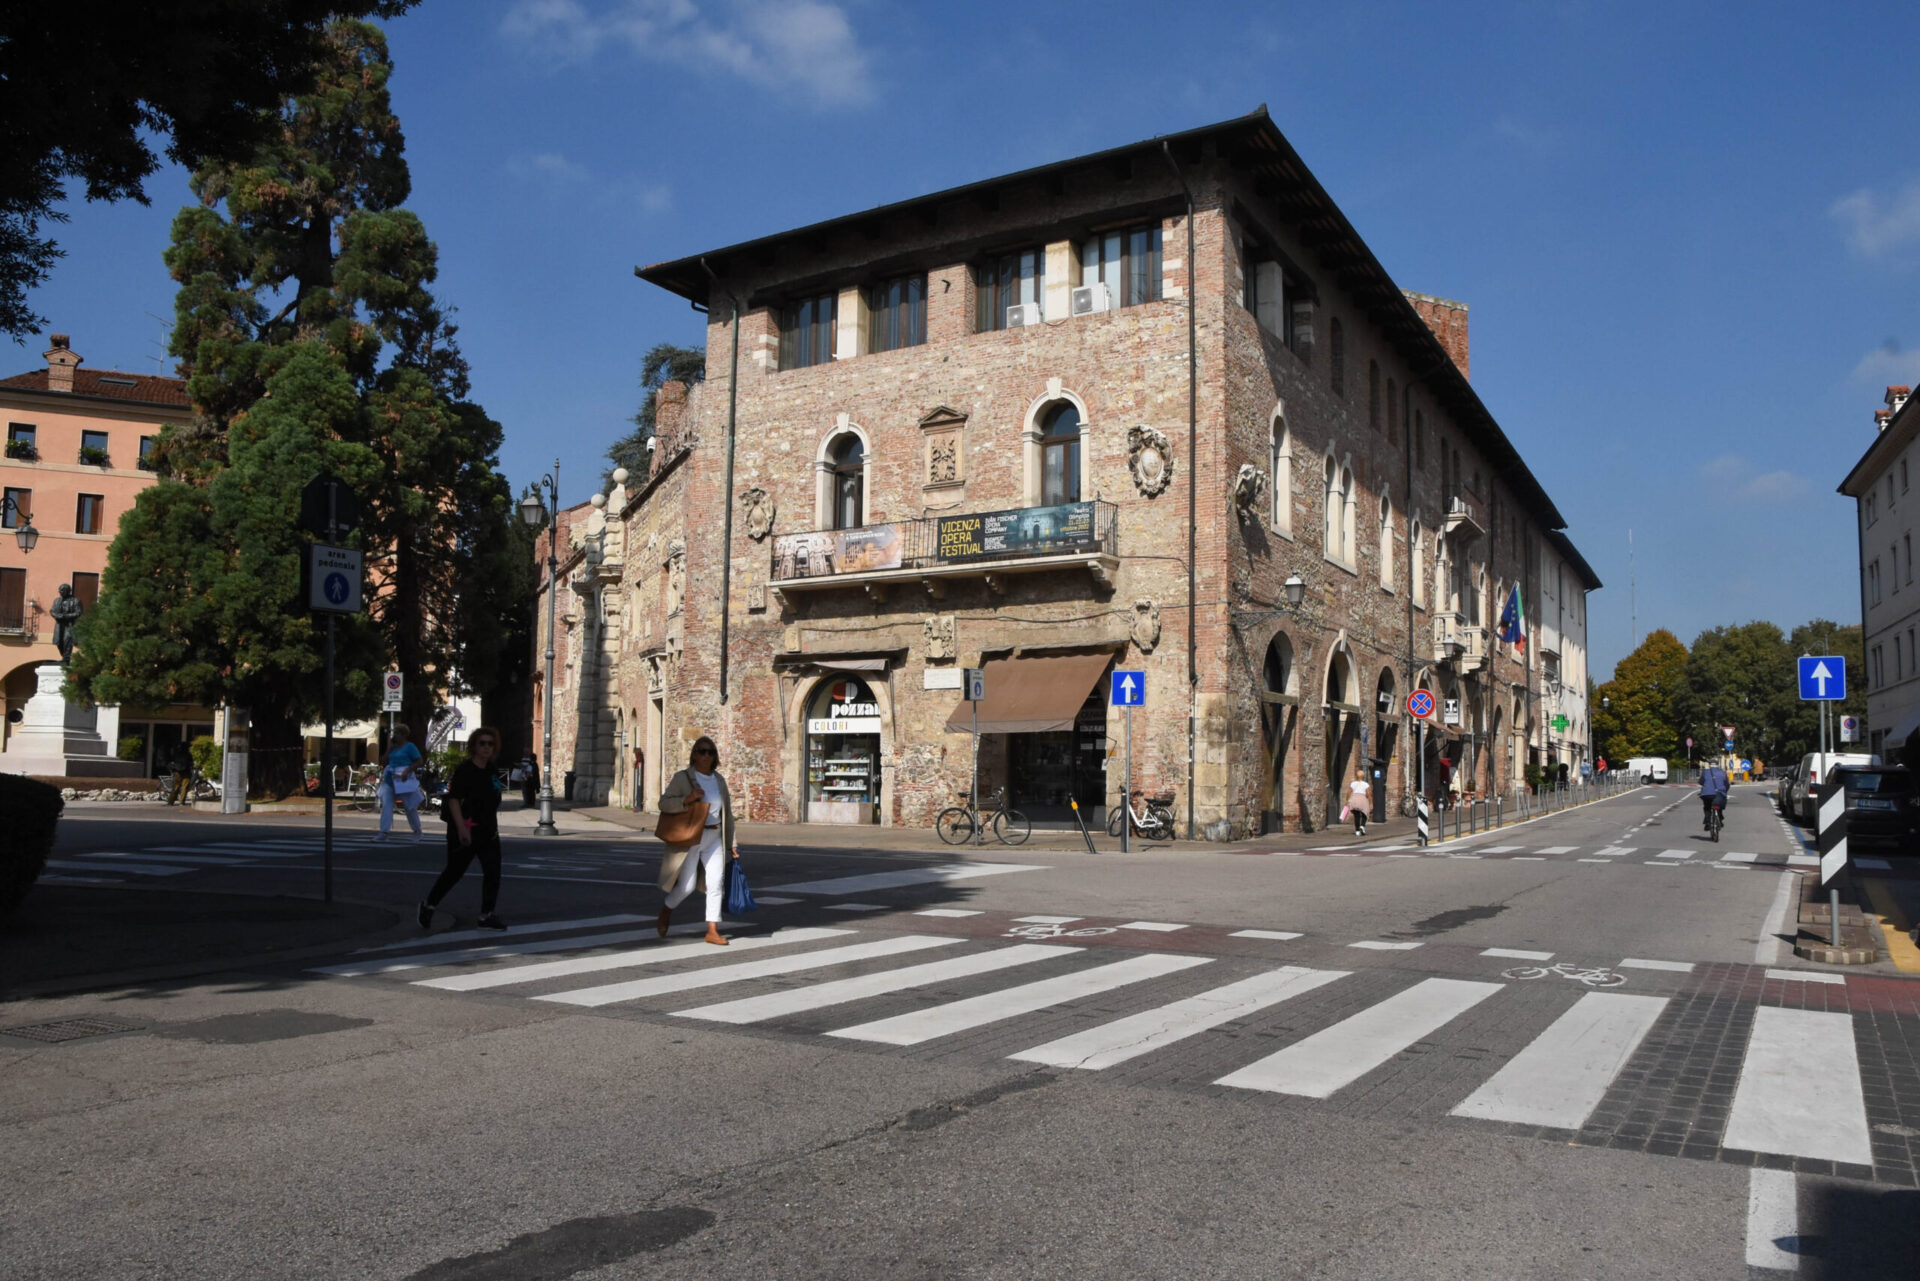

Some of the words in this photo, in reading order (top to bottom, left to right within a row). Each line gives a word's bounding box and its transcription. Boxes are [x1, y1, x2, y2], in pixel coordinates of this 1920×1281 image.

[941, 518, 981, 533] VICENZA
[940, 531, 972, 545] OPERA
[328, 551, 346, 559] area
[940, 543, 983, 557] FESTIVAL
[318, 559, 356, 570] pedonale
